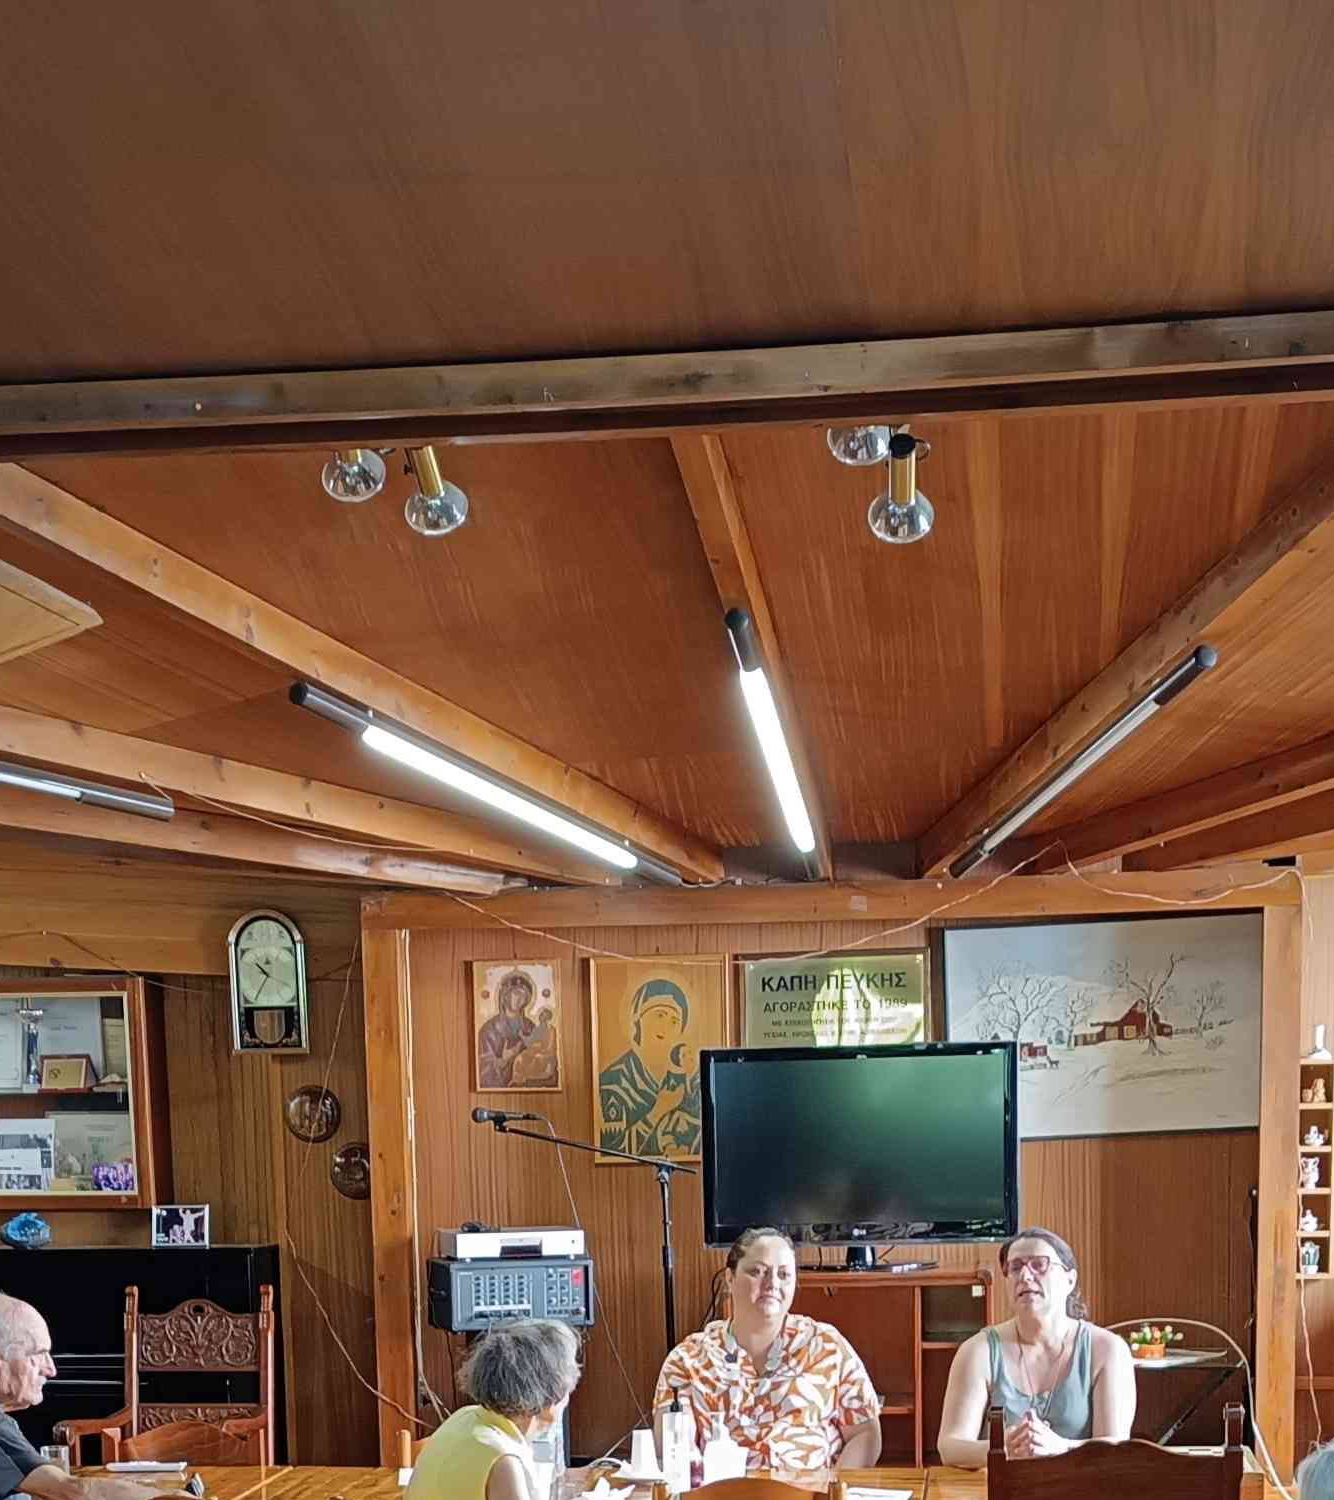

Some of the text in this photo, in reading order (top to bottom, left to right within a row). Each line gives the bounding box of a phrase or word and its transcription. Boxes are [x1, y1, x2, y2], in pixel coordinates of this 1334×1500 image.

[761, 972, 907, 992] ΚΑΠΗ ΠΕΥΚΗΣ
[763, 1000, 848, 1013] ΑΓΟΡΑΣΤΗΚΕ
